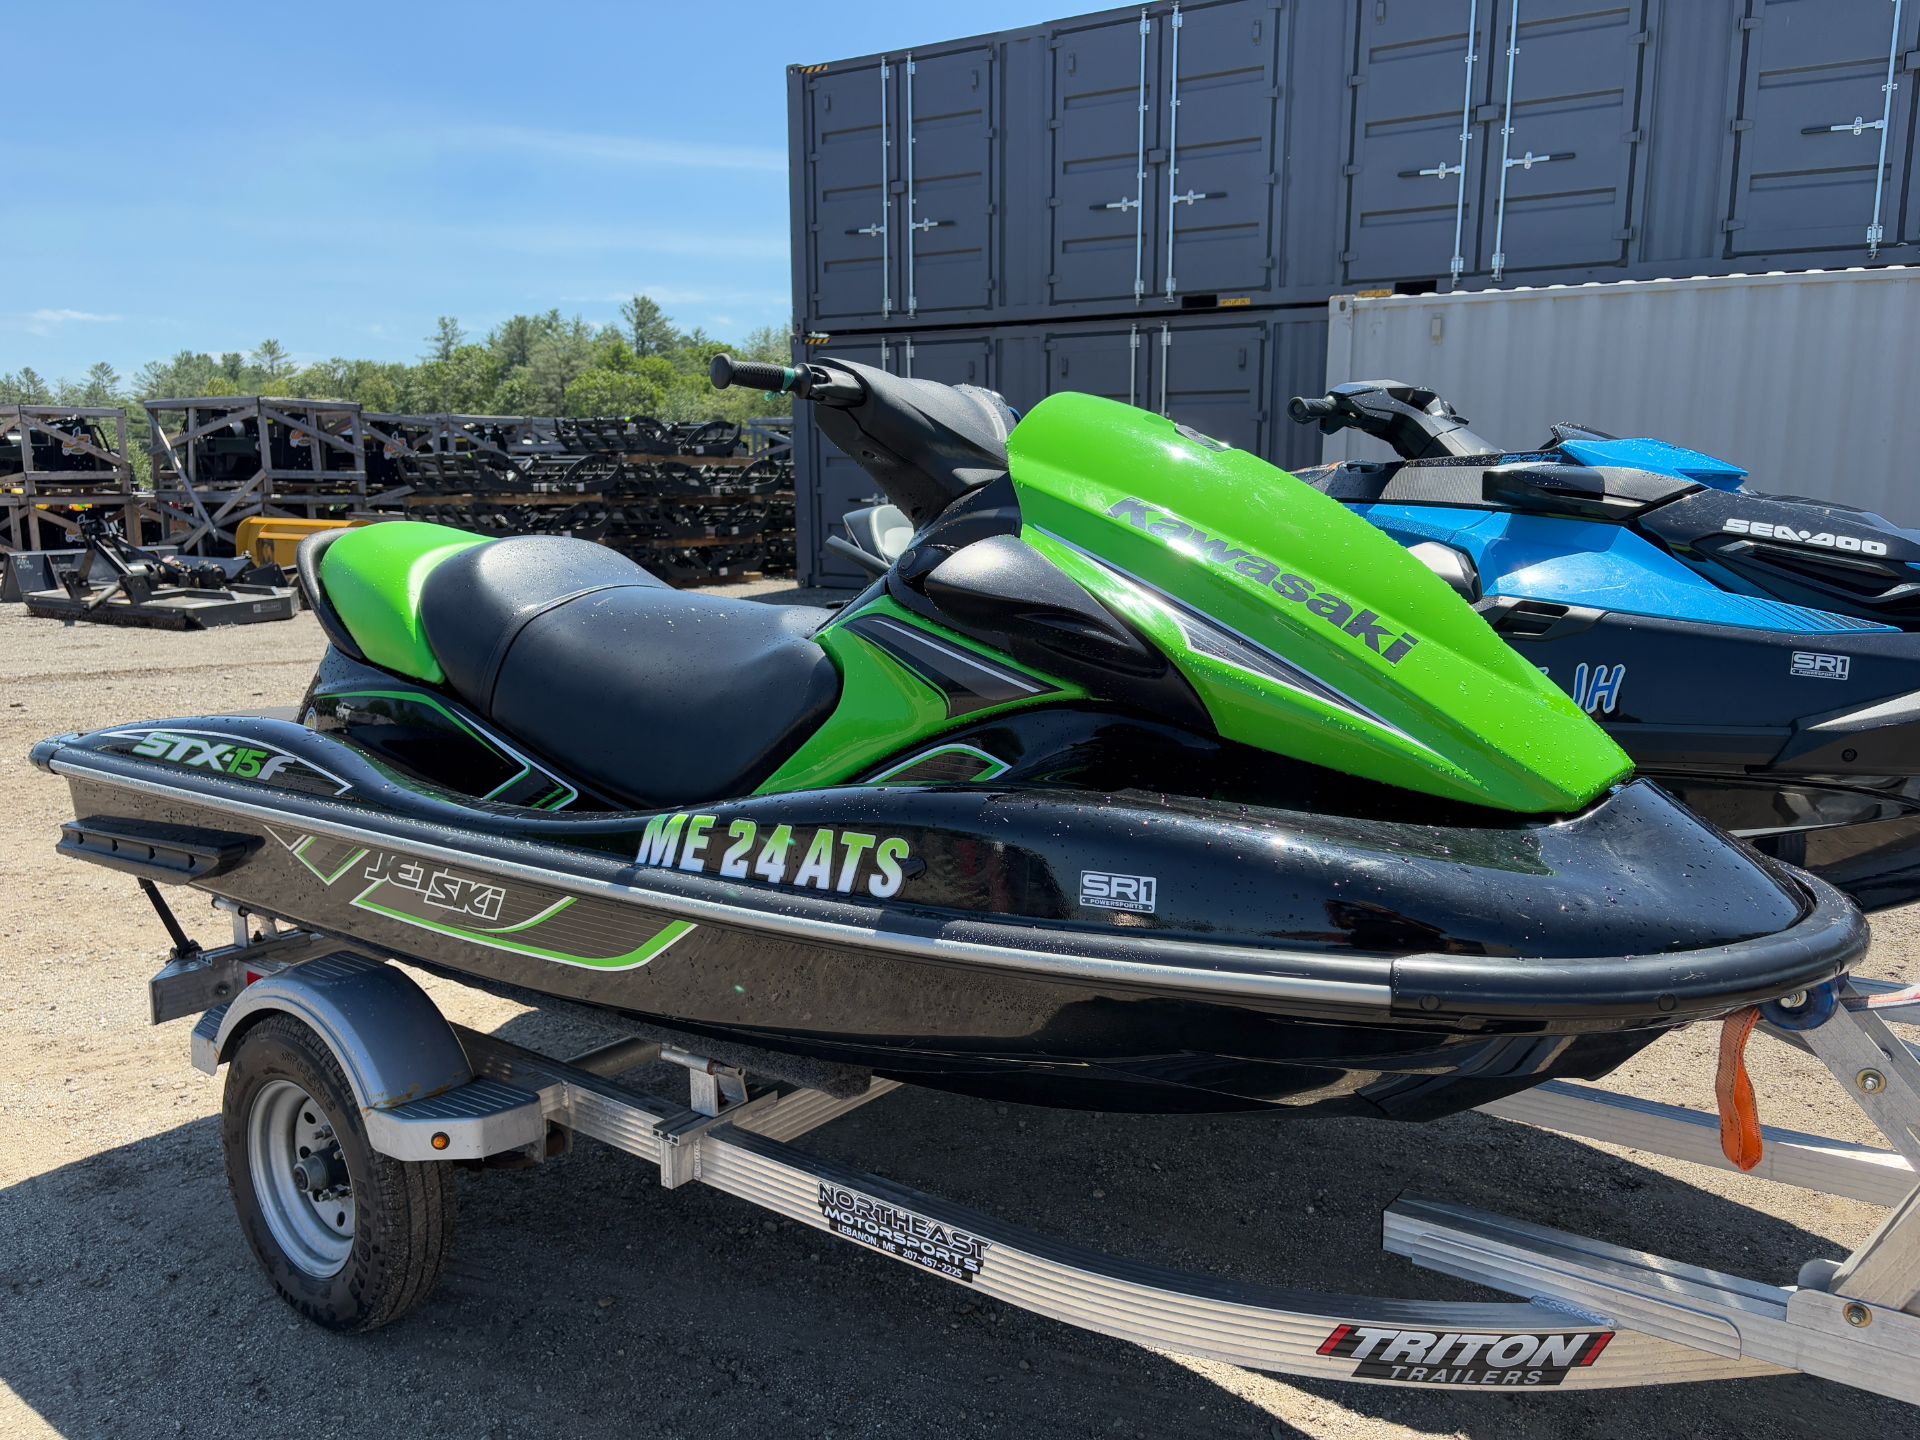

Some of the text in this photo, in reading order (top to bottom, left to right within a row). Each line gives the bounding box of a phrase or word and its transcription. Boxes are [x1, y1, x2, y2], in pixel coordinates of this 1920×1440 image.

[1103, 497, 1419, 668] Kawasaki
[1793, 653, 1849, 673] SR1
[635, 813, 910, 899] ME 24 ATS
[1082, 873, 1156, 904] SR1
[1089, 898, 1144, 910] POWERSPORTS
[818, 1181, 992, 1261] NORTHEAST
[824, 1206, 979, 1272] MOTORSPORTS
[837, 1223, 962, 1278] LEBANON, ME 207-457-2225
[1350, 1327, 1589, 1368] TRITON
[1391, 1366, 1544, 1385] TRAILERS
